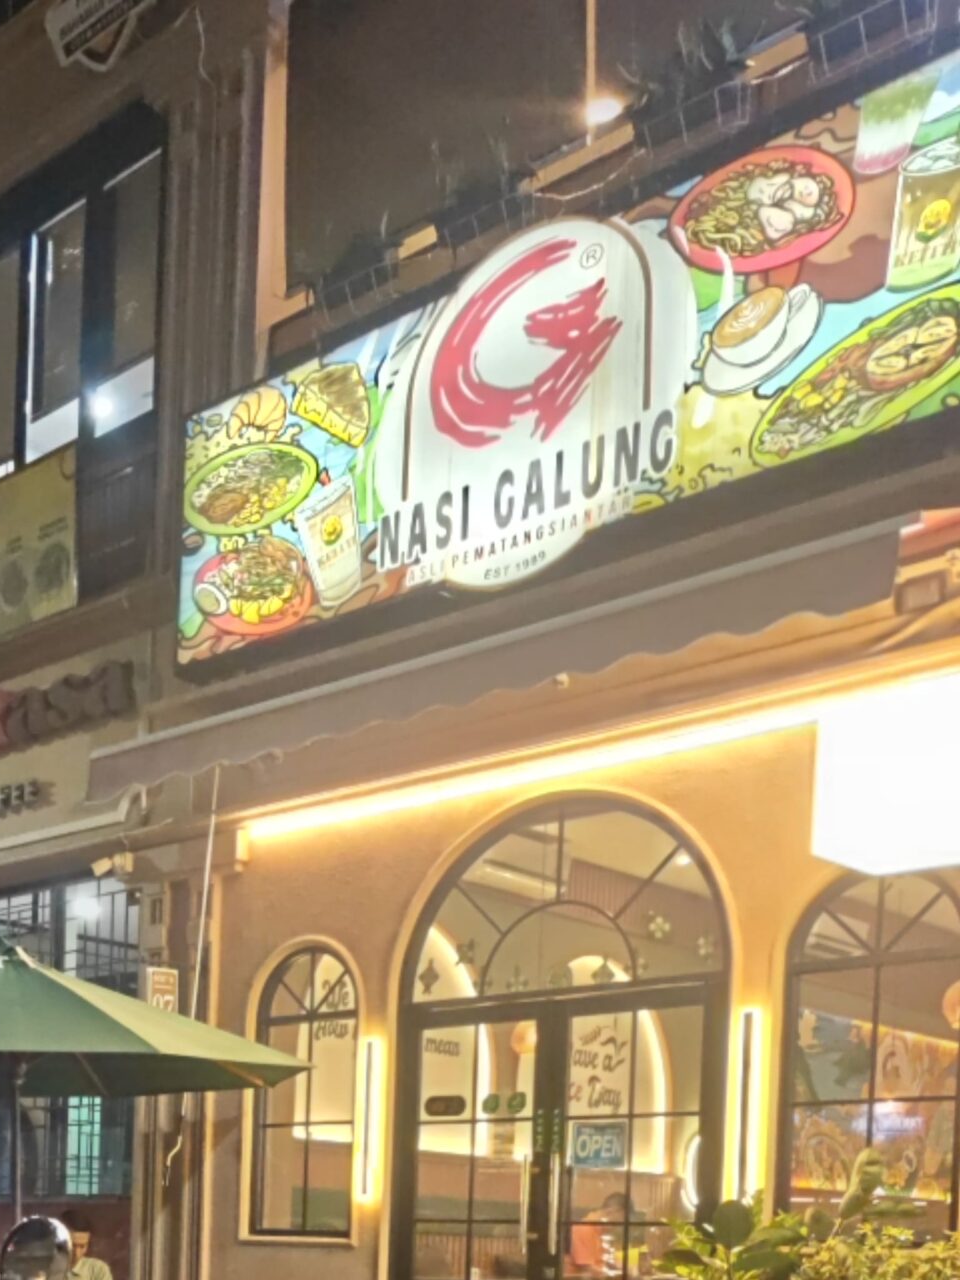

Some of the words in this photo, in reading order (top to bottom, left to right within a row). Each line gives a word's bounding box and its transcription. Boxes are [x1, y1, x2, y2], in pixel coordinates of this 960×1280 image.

[379, 484, 471, 569] NASI
[493, 408, 675, 530] GALUNG
[451, 495, 632, 567] PEMATANGSIANTAR
[483, 564, 512, 581] EST
[575, 1134, 624, 1159] OPEN
